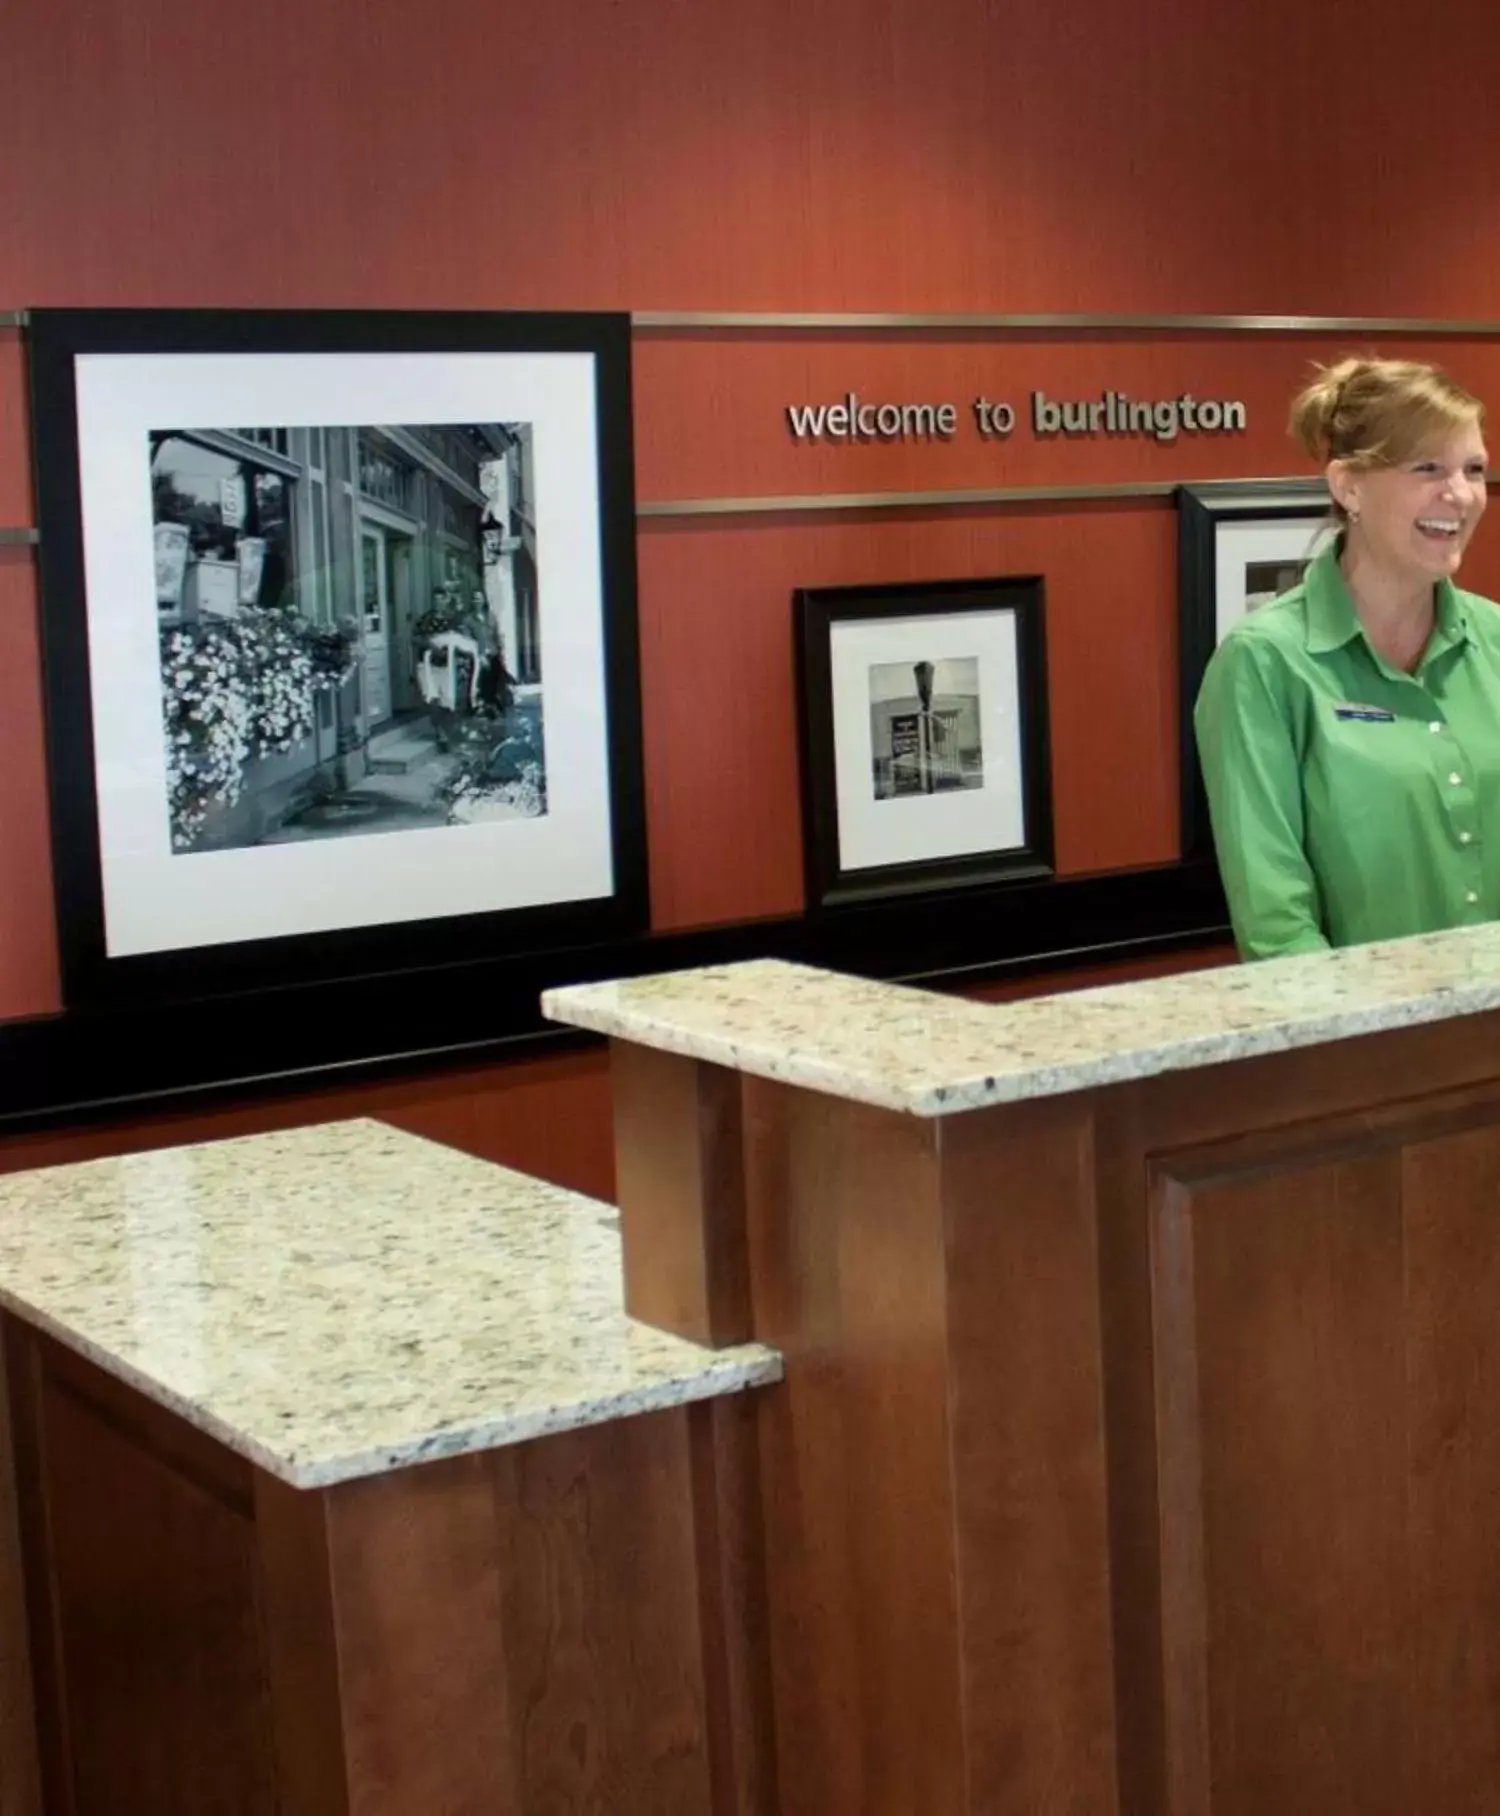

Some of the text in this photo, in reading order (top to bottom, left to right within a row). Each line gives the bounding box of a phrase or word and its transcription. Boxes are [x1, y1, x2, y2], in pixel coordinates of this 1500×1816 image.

[788, 391, 1247, 440] welcome to burlington
